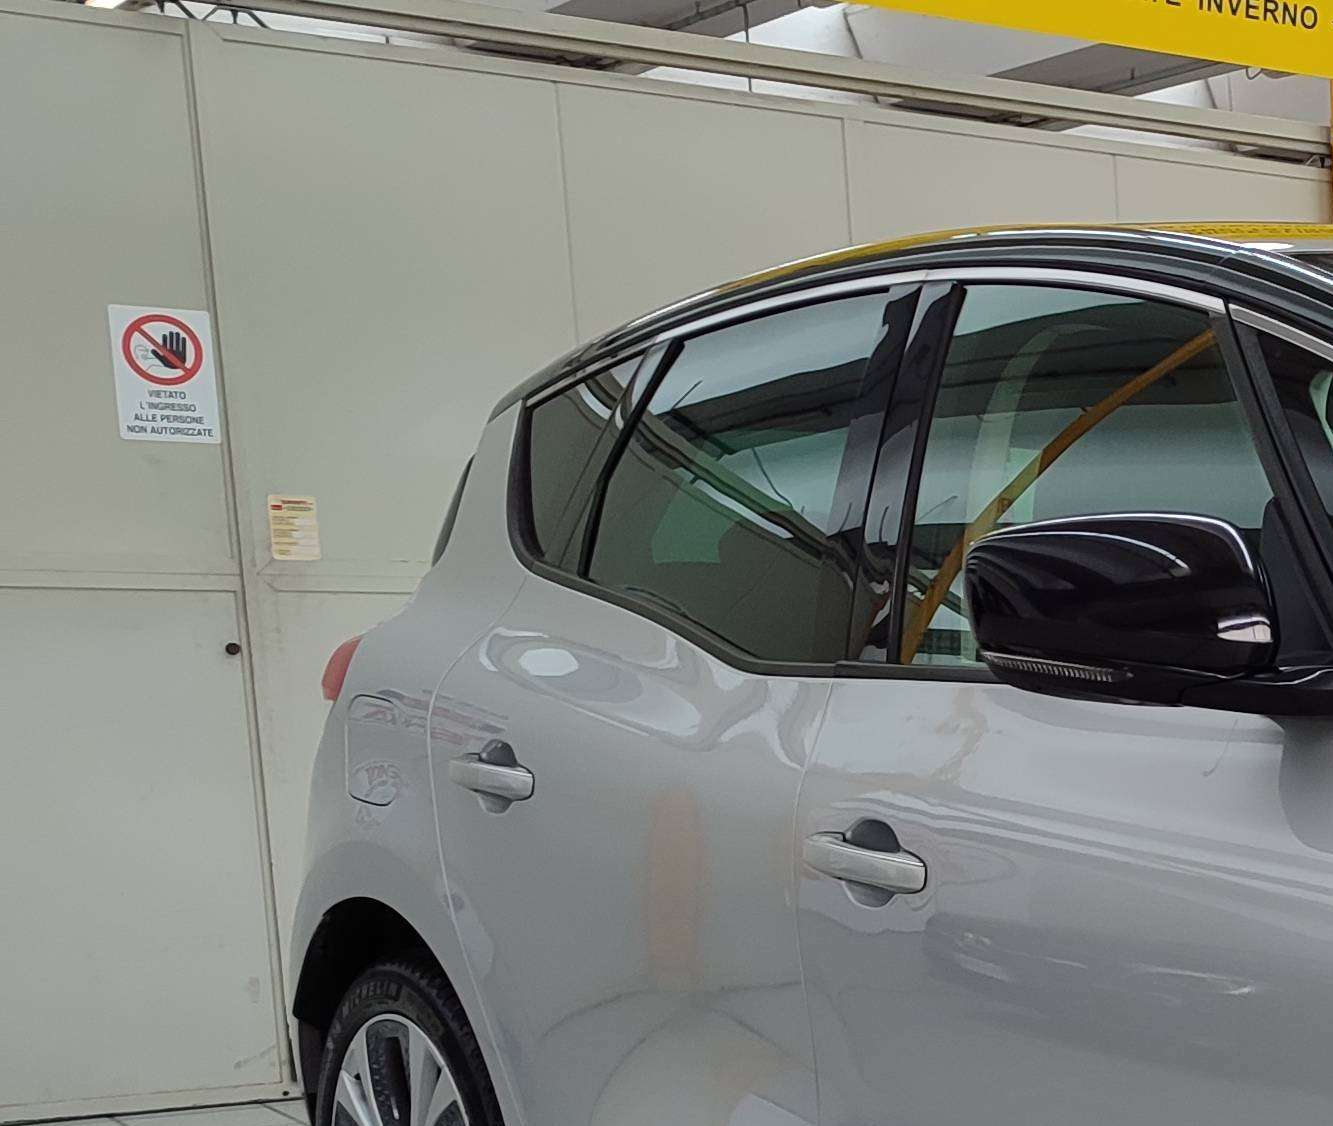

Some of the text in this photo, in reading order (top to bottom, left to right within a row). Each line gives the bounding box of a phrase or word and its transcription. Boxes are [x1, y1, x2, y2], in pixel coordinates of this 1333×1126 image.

[1198, 0, 1318, 29] INVERNO
[148, 390, 186, 400] VIETATO
[140, 401, 196, 412] L'INGRESSO
[134, 413, 204, 425] ALLE PERSONE
[127, 425, 214, 437] NON AUTORIZZATE
